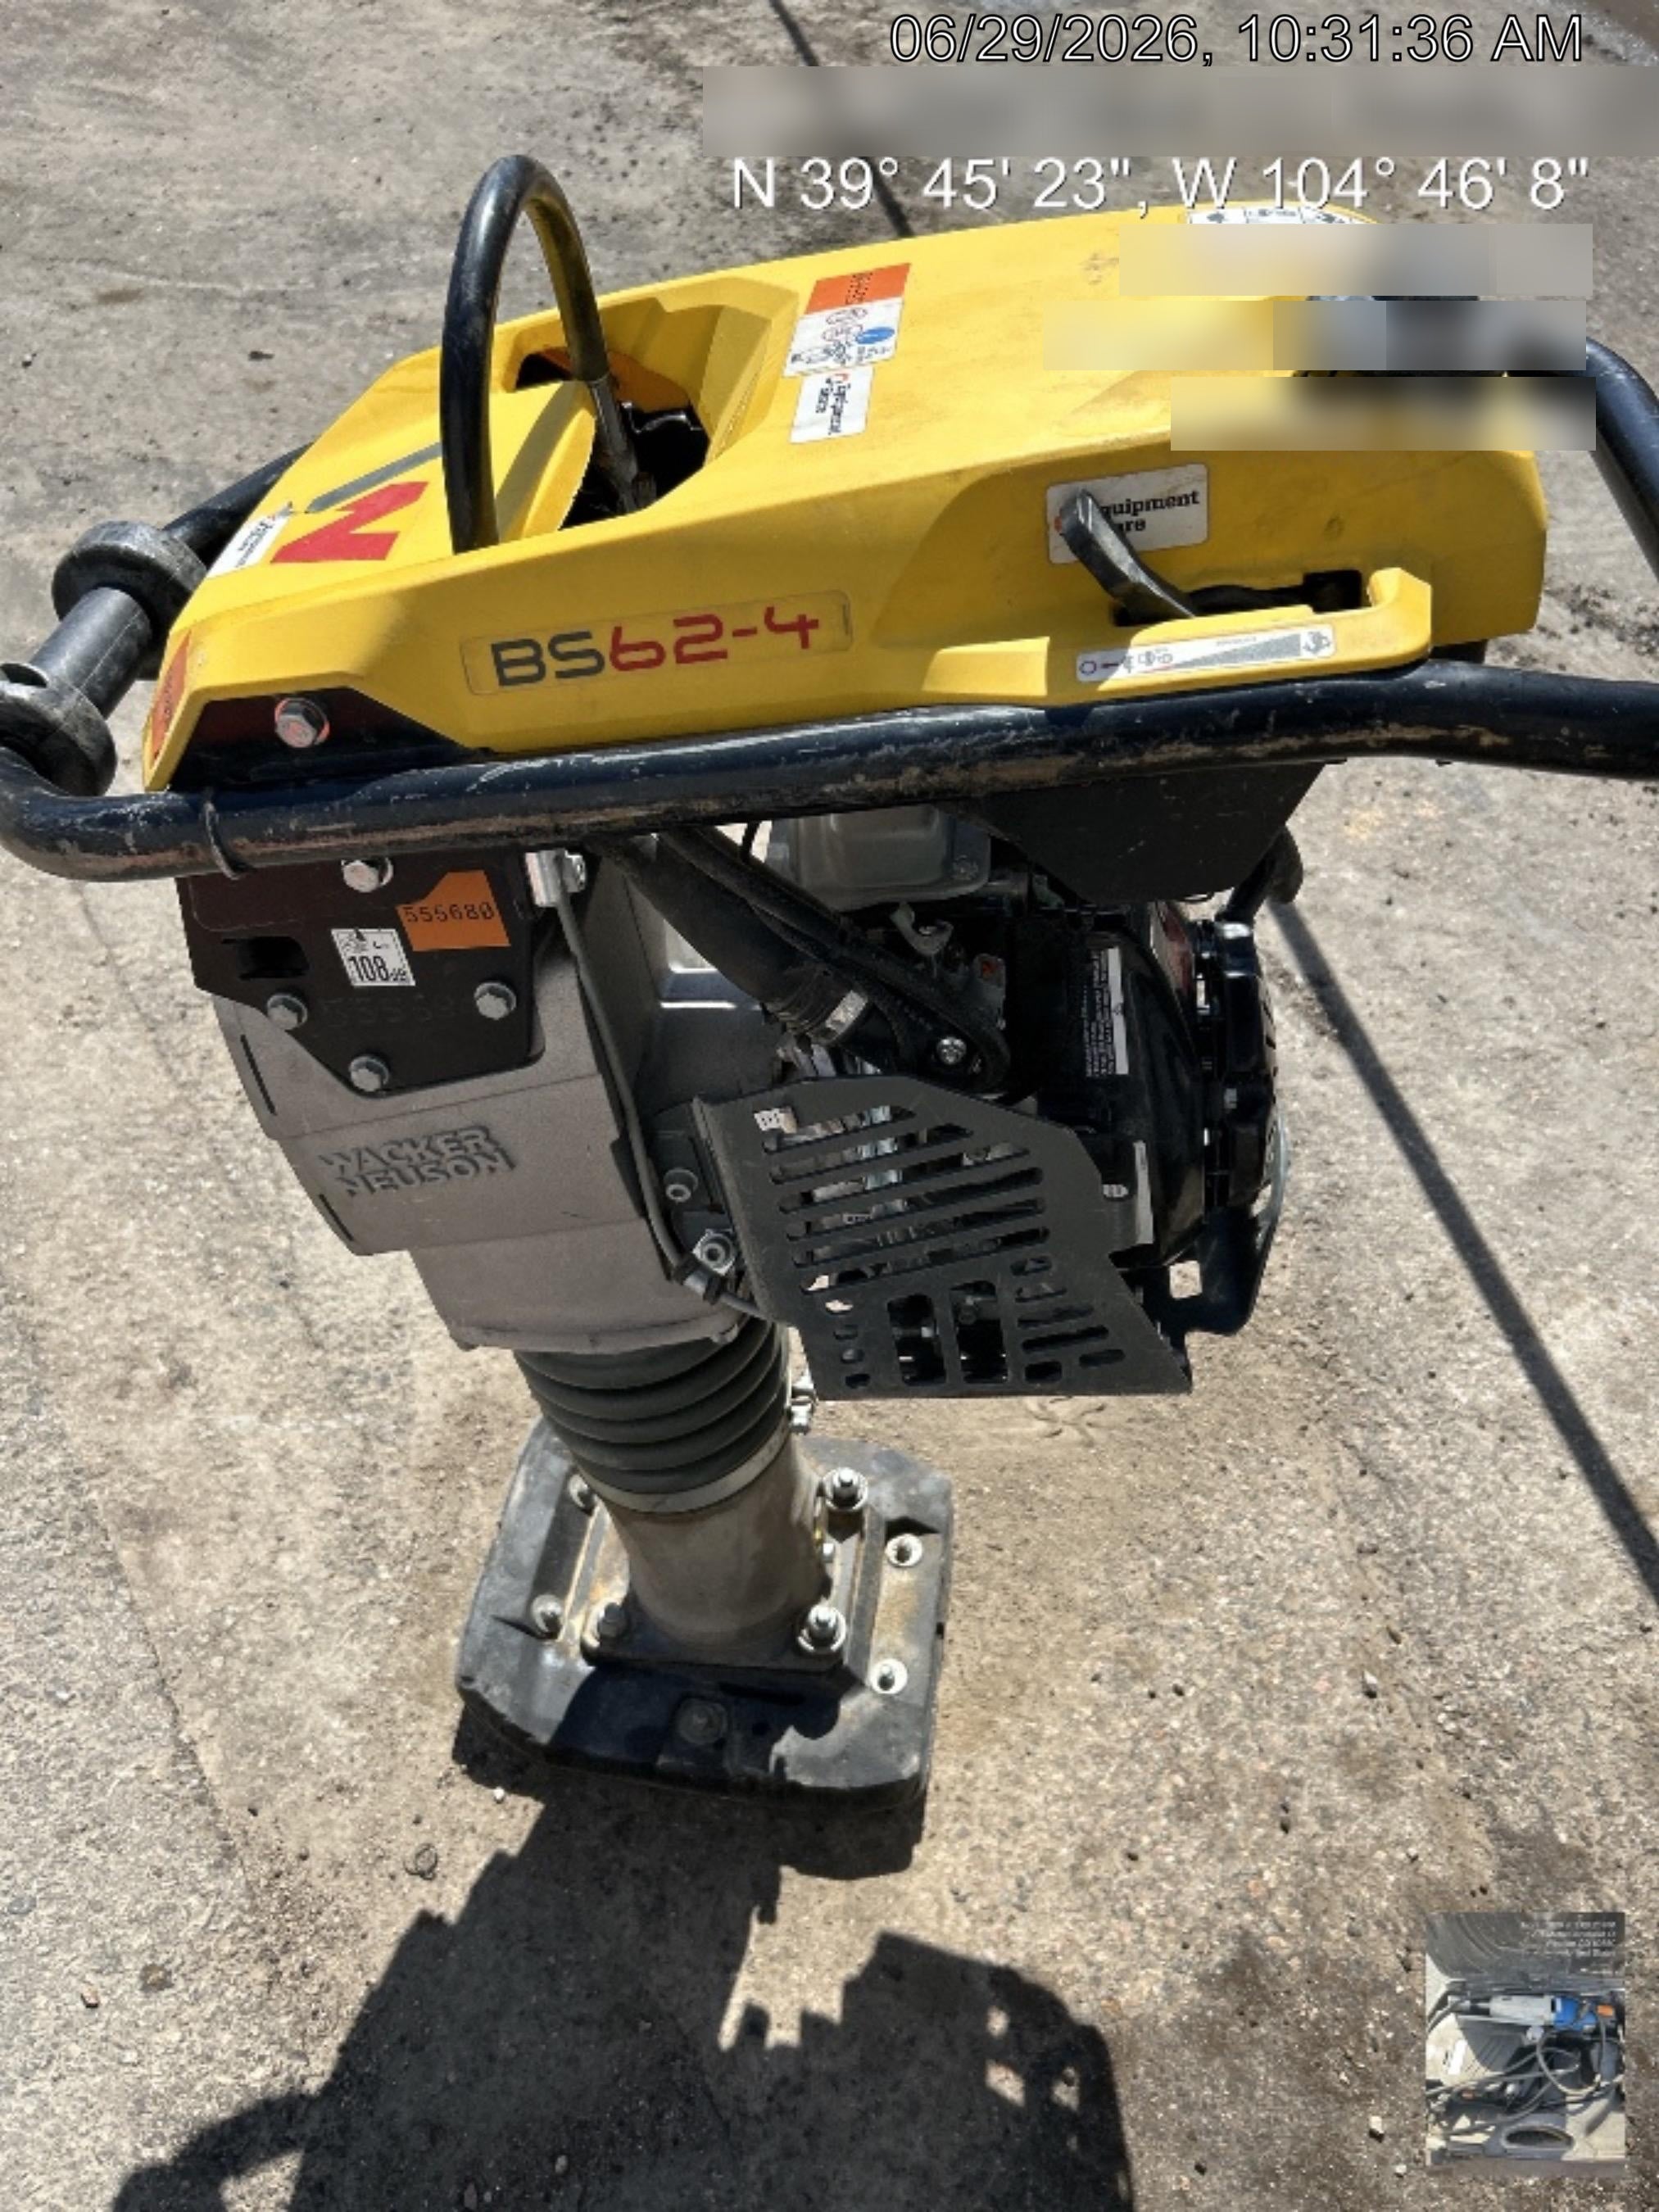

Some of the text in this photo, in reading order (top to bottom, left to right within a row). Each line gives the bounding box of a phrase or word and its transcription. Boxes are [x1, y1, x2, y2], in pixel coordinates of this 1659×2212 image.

[1101, 491, 1199, 519] quipment
[491, 606, 819, 687] BS62-4
[317, 1125, 501, 1174] WACKER
[336, 1147, 516, 1198] NEUSON
